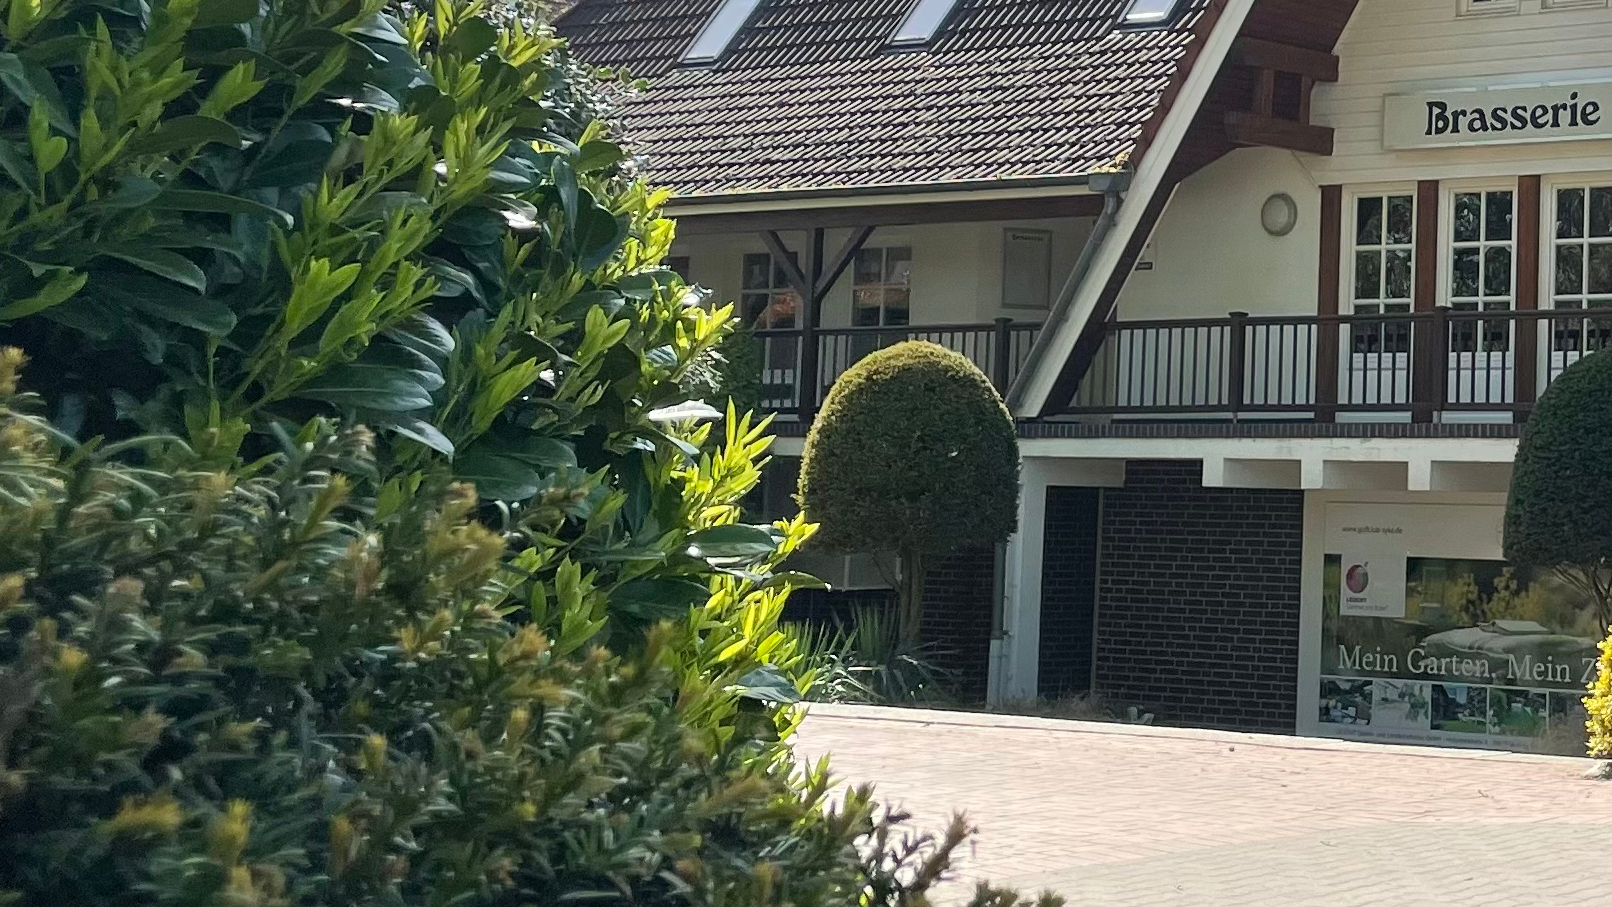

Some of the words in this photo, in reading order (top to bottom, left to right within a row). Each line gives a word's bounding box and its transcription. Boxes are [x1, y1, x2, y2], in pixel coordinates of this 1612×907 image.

[1425, 91, 1600, 135] Brasserie
[1338, 644, 1398, 672] Mein
[1407, 648, 1496, 678] Garten.
[1507, 653, 1571, 682] Mein
